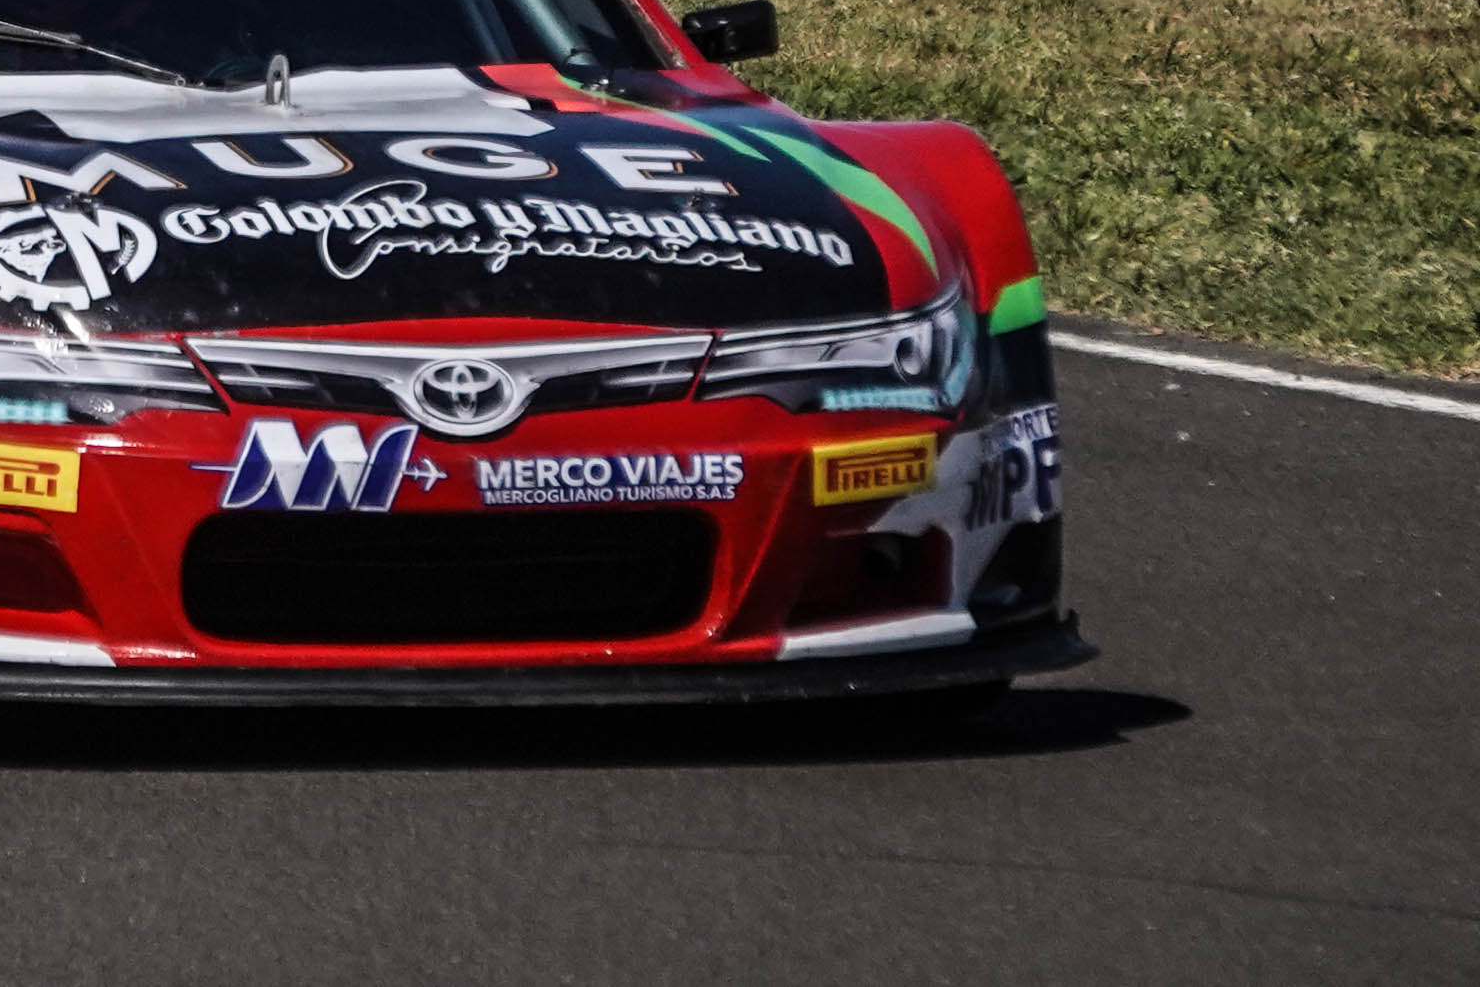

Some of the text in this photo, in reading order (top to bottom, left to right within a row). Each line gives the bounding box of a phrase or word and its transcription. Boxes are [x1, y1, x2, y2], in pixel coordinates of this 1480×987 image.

[164, 193, 855, 267] Colombo y Magliano
[321, 179, 764, 281] Consignatarios
[477, 454, 744, 490] MERCO VIAJES
[826, 447, 928, 493] PIRELLI
[483, 488, 613, 506] MERCOGLIANO
[615, 486, 693, 503] TURISMO
